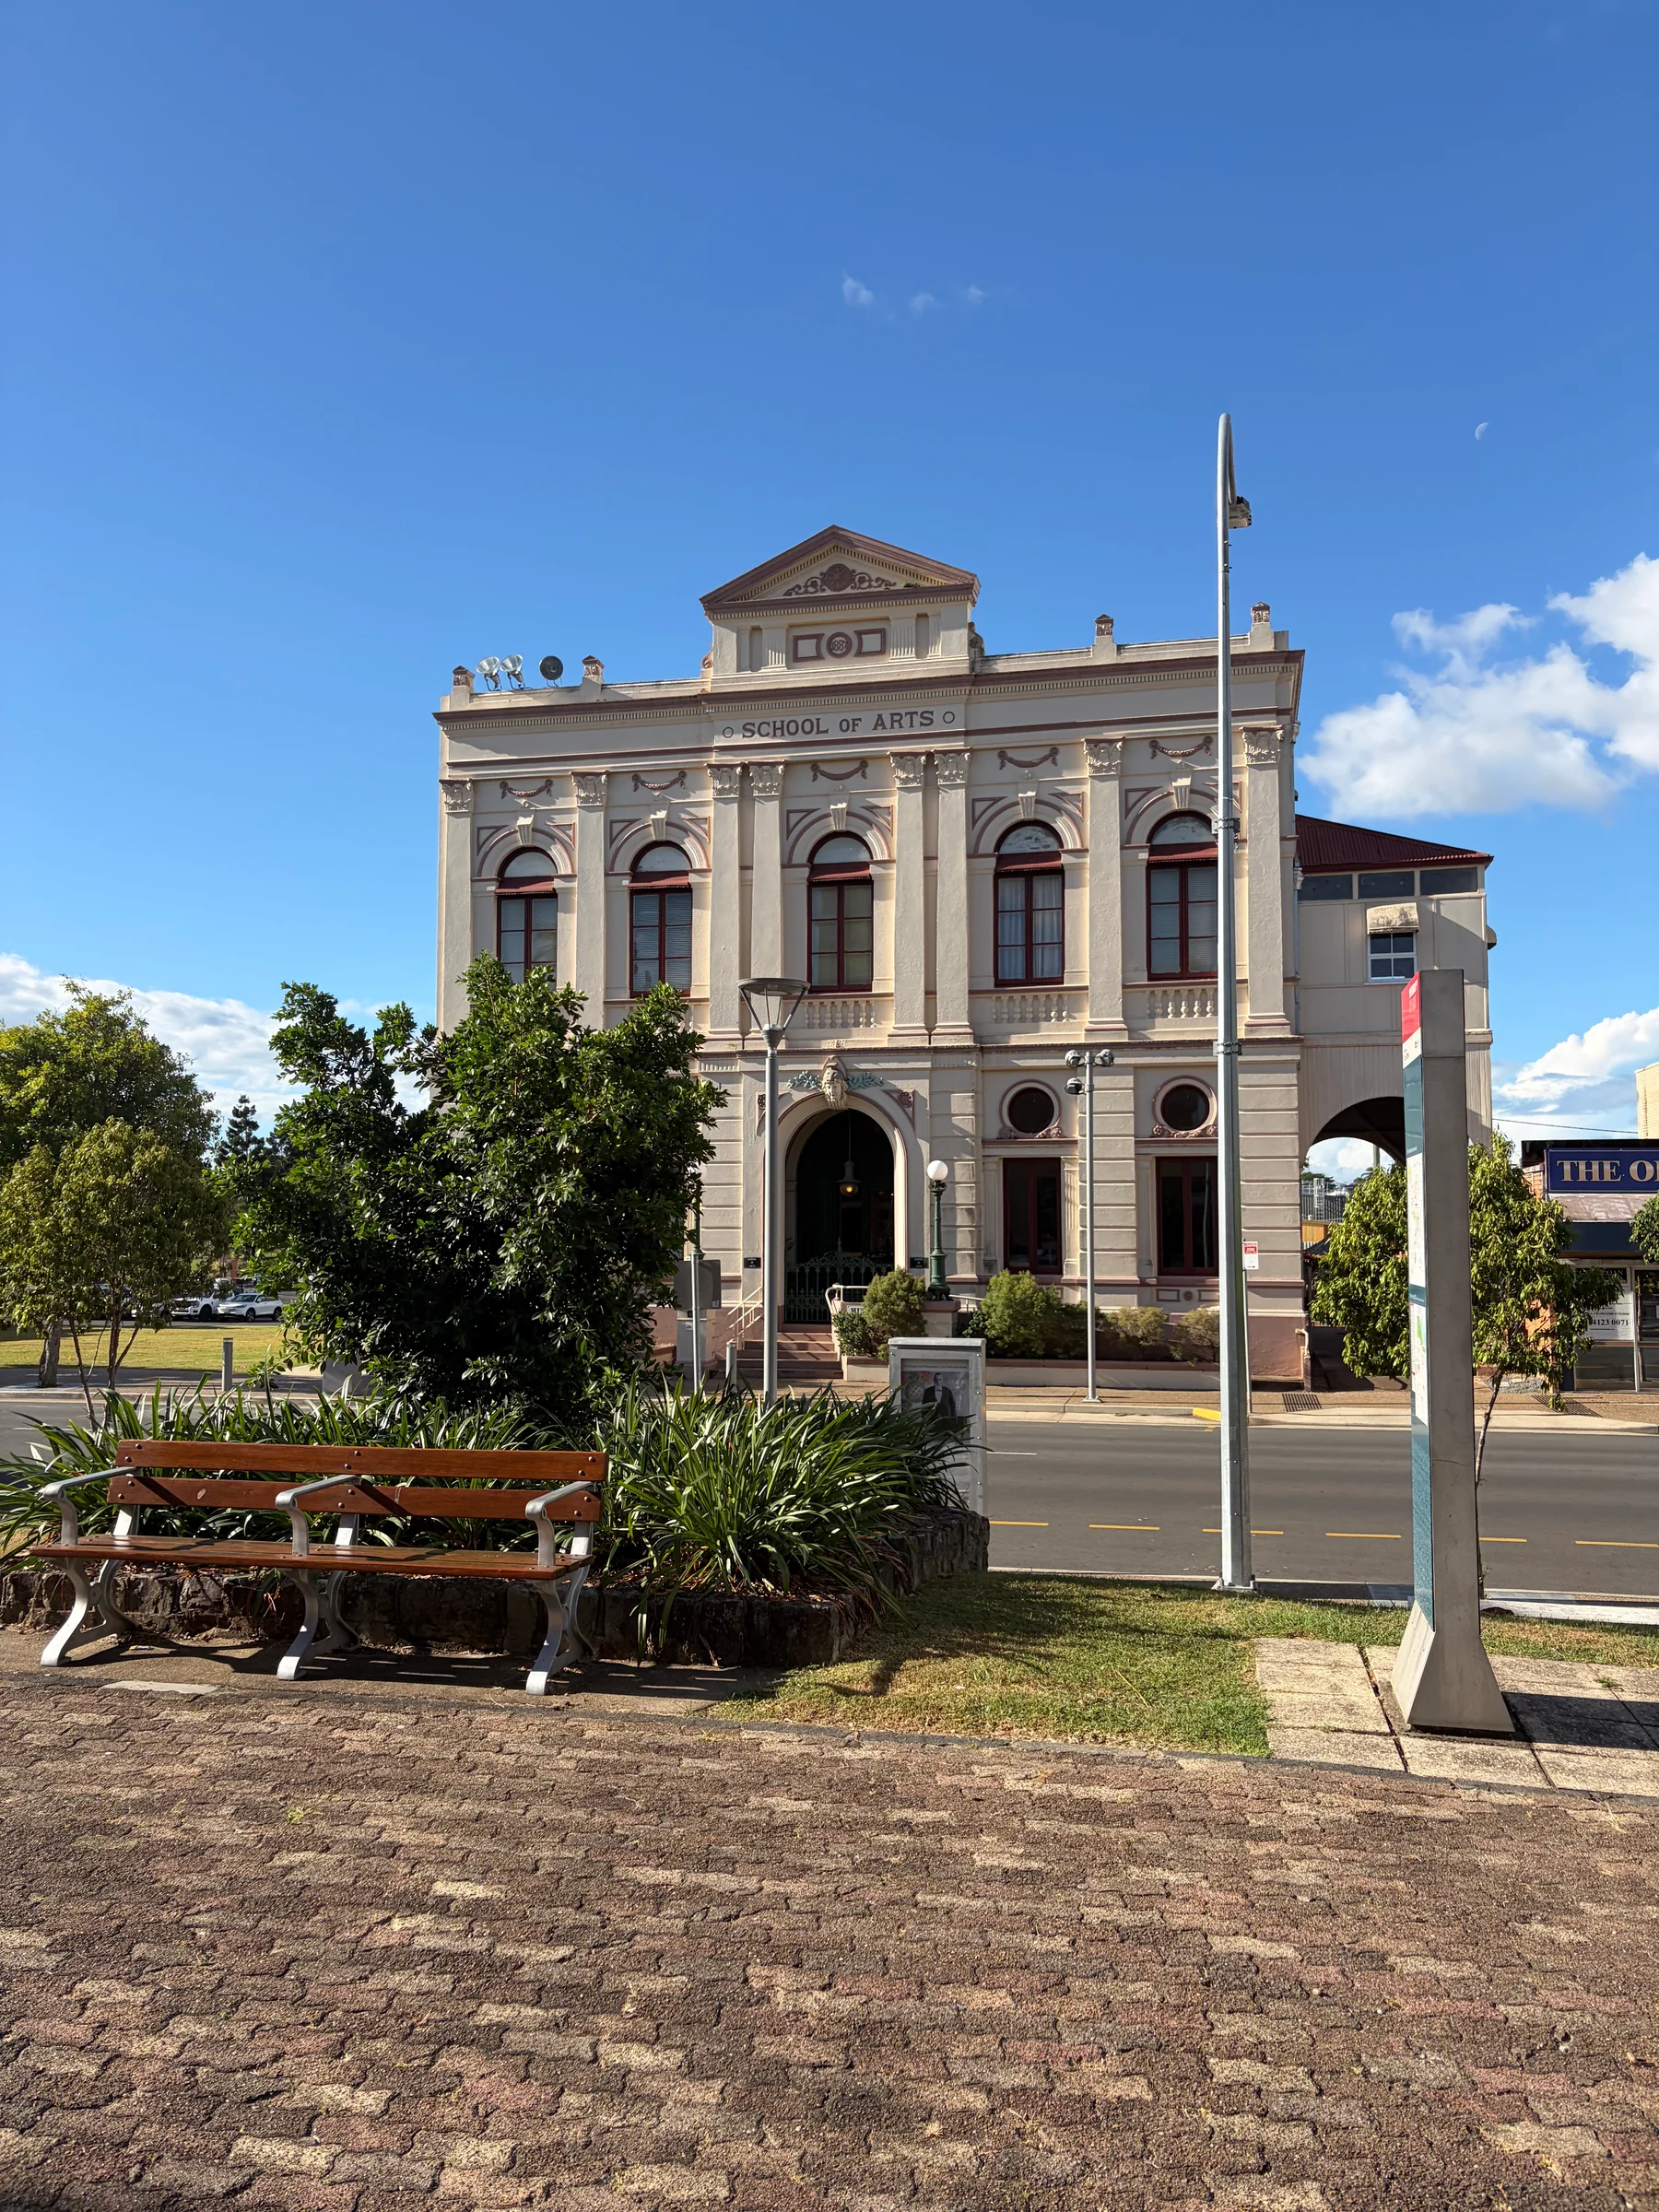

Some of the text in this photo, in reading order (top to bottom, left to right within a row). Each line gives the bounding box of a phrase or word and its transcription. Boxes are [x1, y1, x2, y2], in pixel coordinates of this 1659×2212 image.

[742, 710, 935, 738] SCHOOL OF ARTS
[1557, 1160, 1659, 1182] THE O
